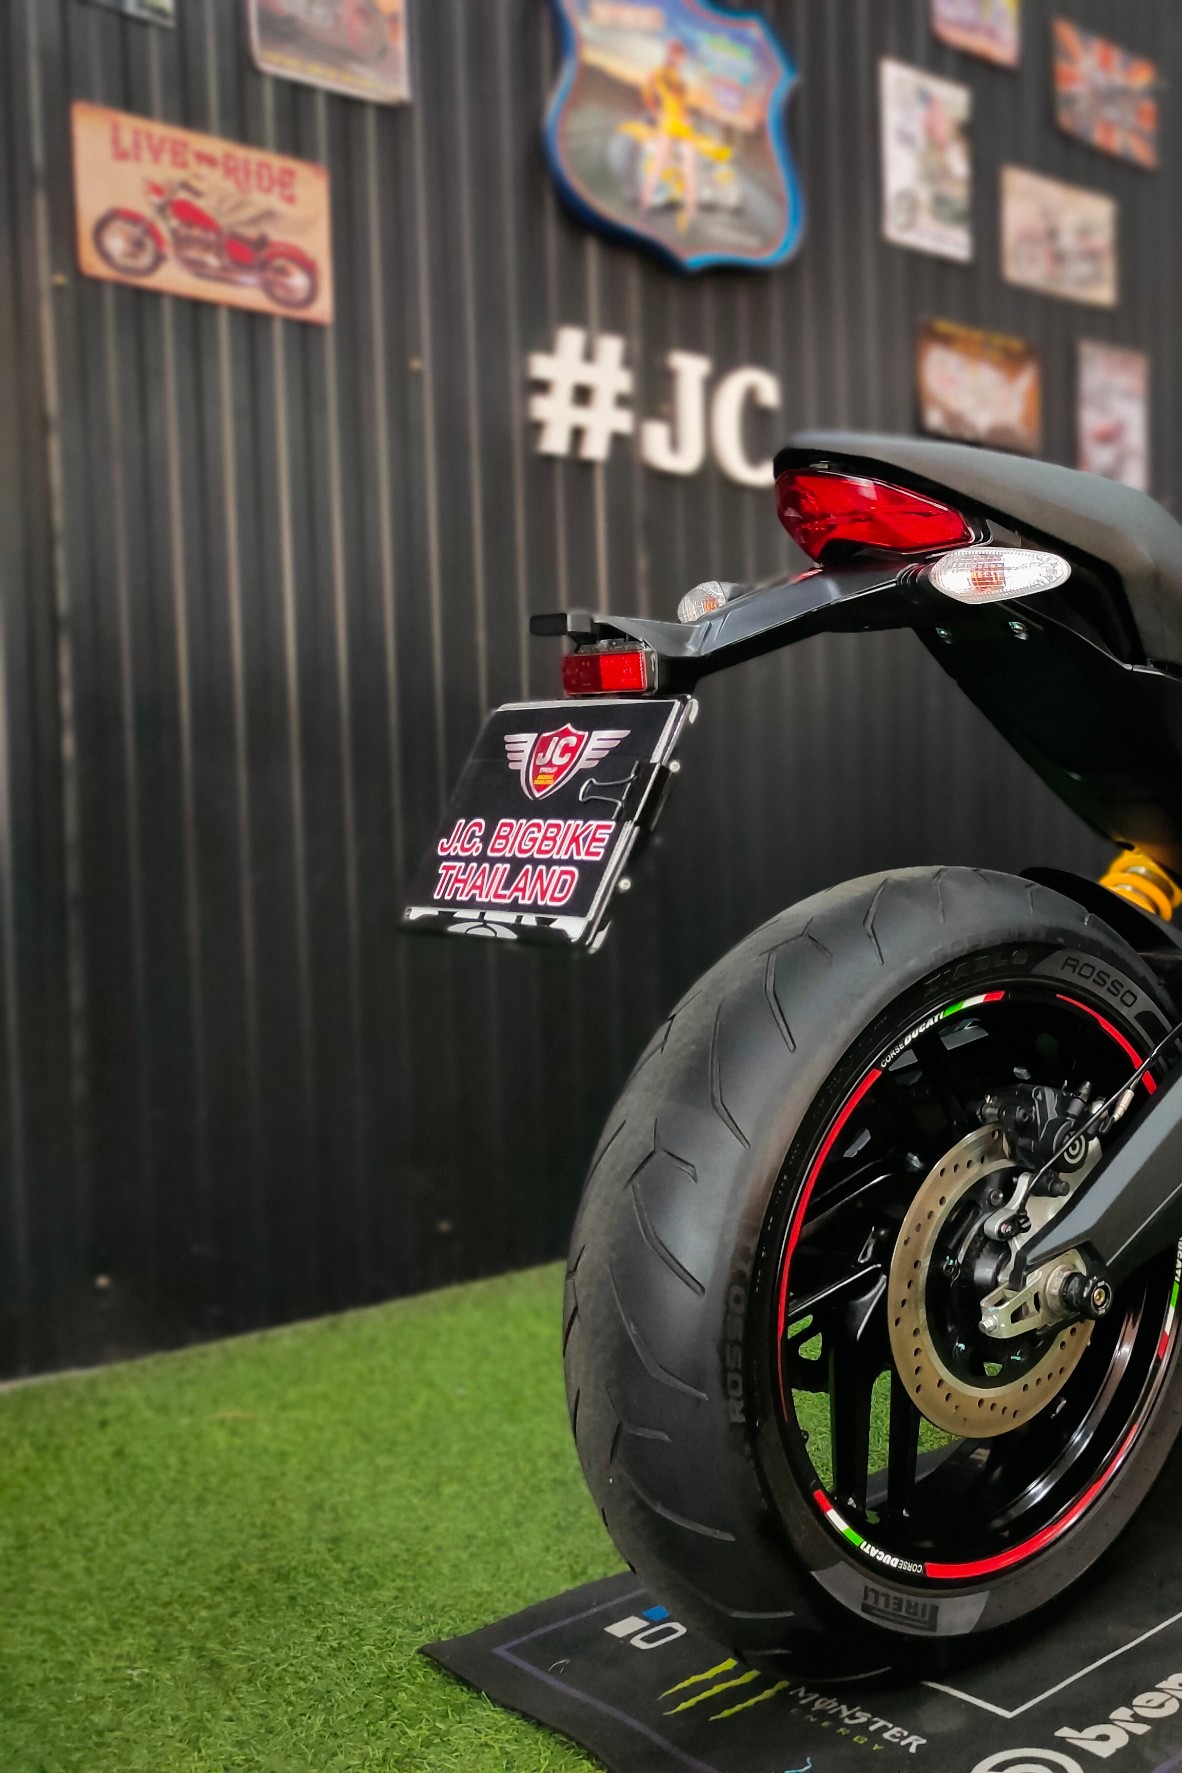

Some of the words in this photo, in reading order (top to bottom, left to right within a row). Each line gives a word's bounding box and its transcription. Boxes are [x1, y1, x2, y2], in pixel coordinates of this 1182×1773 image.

[109, 119, 190, 170] LIVE
[527, 324, 781, 489] #JC
[535, 735, 578, 766] JC
[438, 818, 486, 857] J.C.
[487, 818, 616, 861] BIGBIKE
[434, 861, 579, 906] THAILAND
[1060, 955, 1138, 1009] ROSSO
[903, 1009, 945, 1046] DUCATI
[859, 1540, 900, 1568] DUCATI
[861, 1585, 939, 1632] PIRELLI
